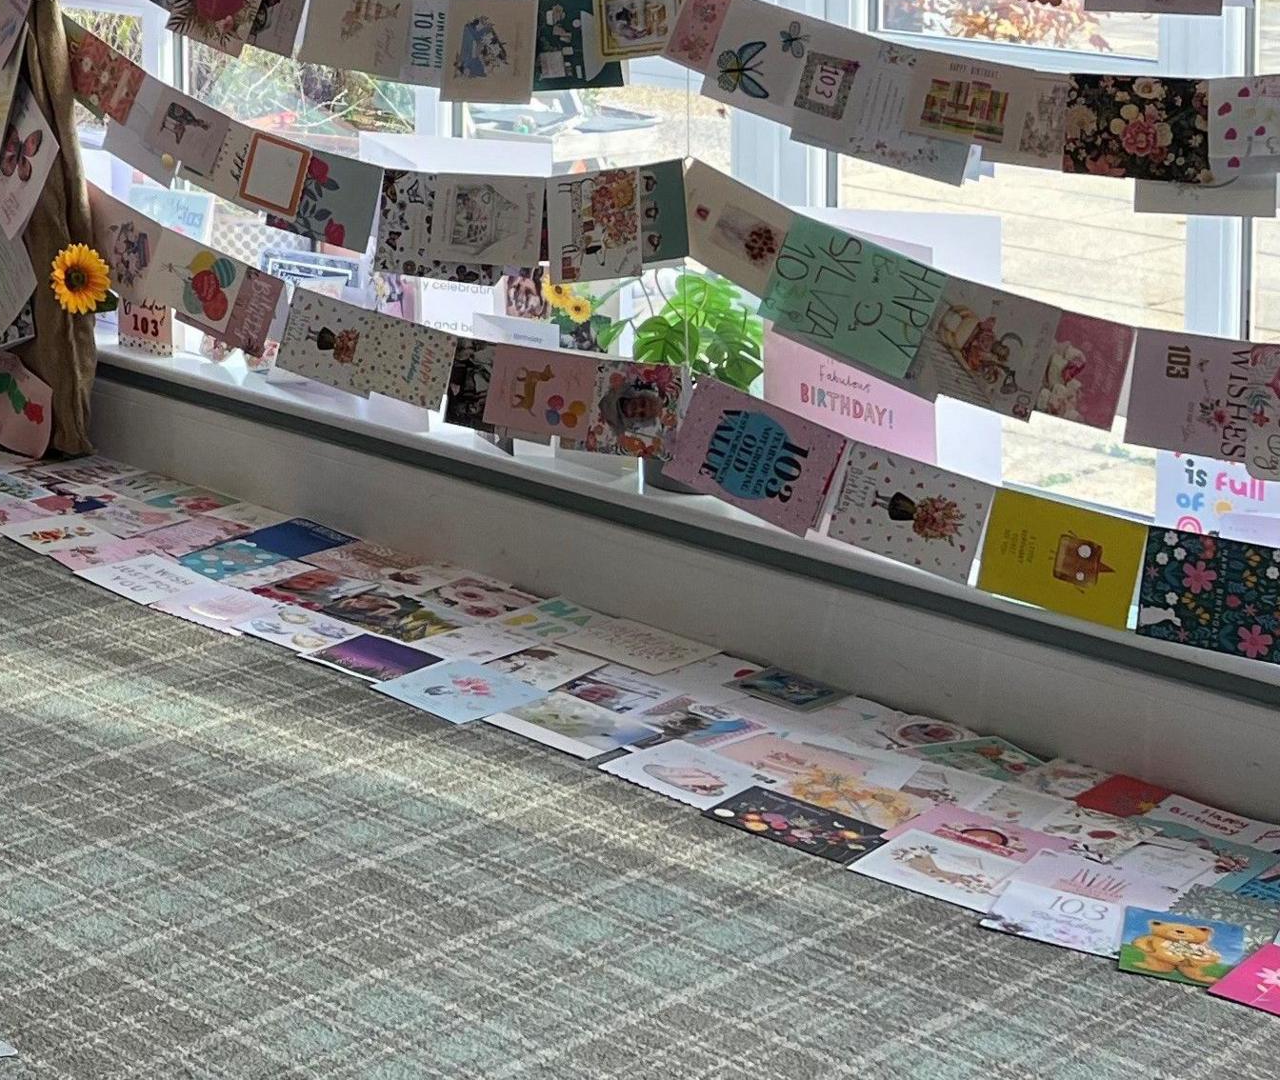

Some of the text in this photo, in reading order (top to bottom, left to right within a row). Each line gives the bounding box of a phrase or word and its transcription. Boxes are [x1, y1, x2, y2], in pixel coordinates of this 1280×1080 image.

[413, 11, 434, 29] TO
[431, 280, 495, 296] celebratin
[803, 236, 864, 341] SYLVIA
[131, 313, 159, 338] 103
[877, 258, 948, 359] HAPPY
[402, 339, 425, 384] Birthday
[420, 347, 436, 386] HAPPY
[819, 363, 872, 394] Fabulous
[1166, 344, 1192, 381] 103
[800, 382, 895, 430] BIRTHDAY!
[1220, 347, 1252, 463] WISHES
[698, 407, 743, 483] VALUE
[732, 433, 758, 474] OLD
[761, 431, 783, 463] YEARS
[740, 446, 766, 493] GROWING
[750, 477, 764, 498] AGE
[765, 440, 810, 504] 103
[1184, 458, 1265, 502] is full
[856, 476, 876, 508] Happy
[1175, 492, 1205, 513] of
[1217, 548, 1229, 584] HAPPY
[1169, 806, 1240, 836] Birthday
[1201, 807, 1251, 830] Happy
[1049, 894, 1110, 921] 103
